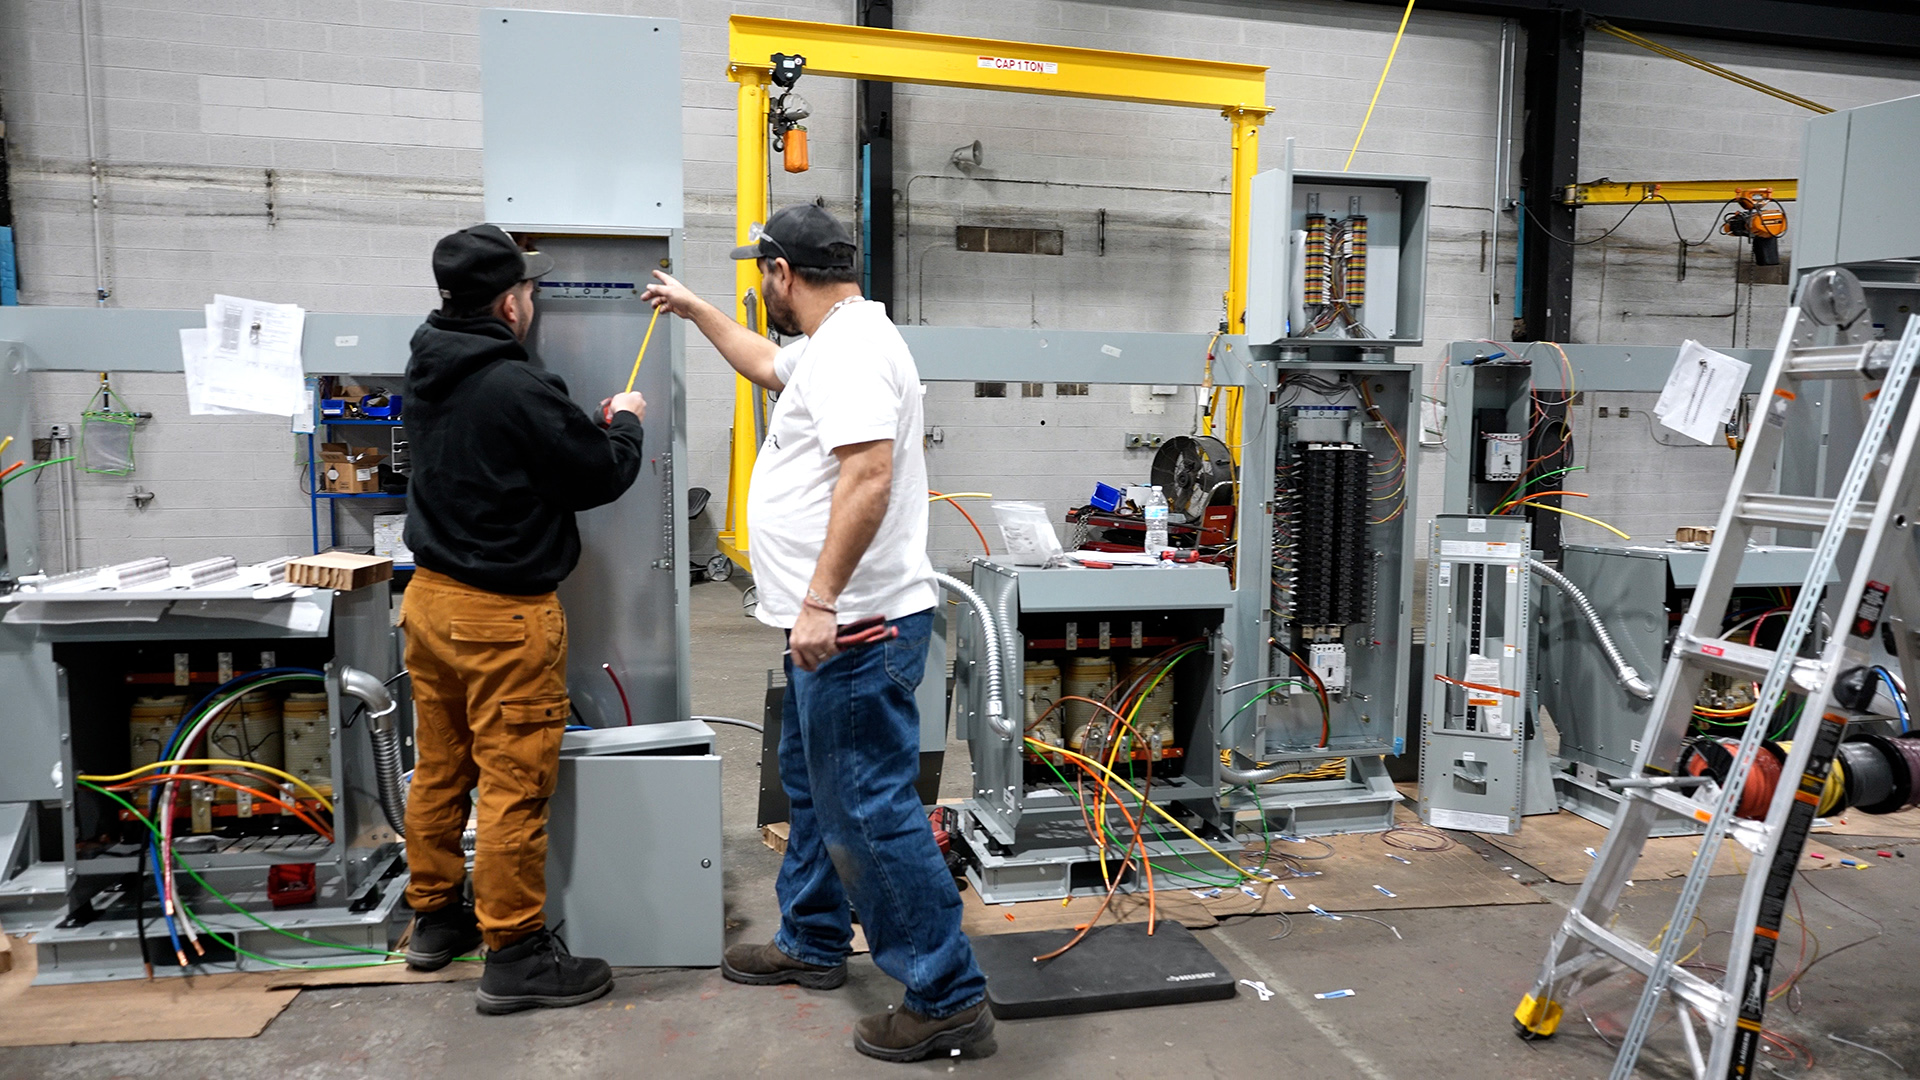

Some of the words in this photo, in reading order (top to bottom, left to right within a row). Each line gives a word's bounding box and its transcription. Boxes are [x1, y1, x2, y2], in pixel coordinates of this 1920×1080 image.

[996, 58, 1015, 69] CAP
[1017, 60, 1022, 70] 1
[1024, 60, 1044, 72] TON
